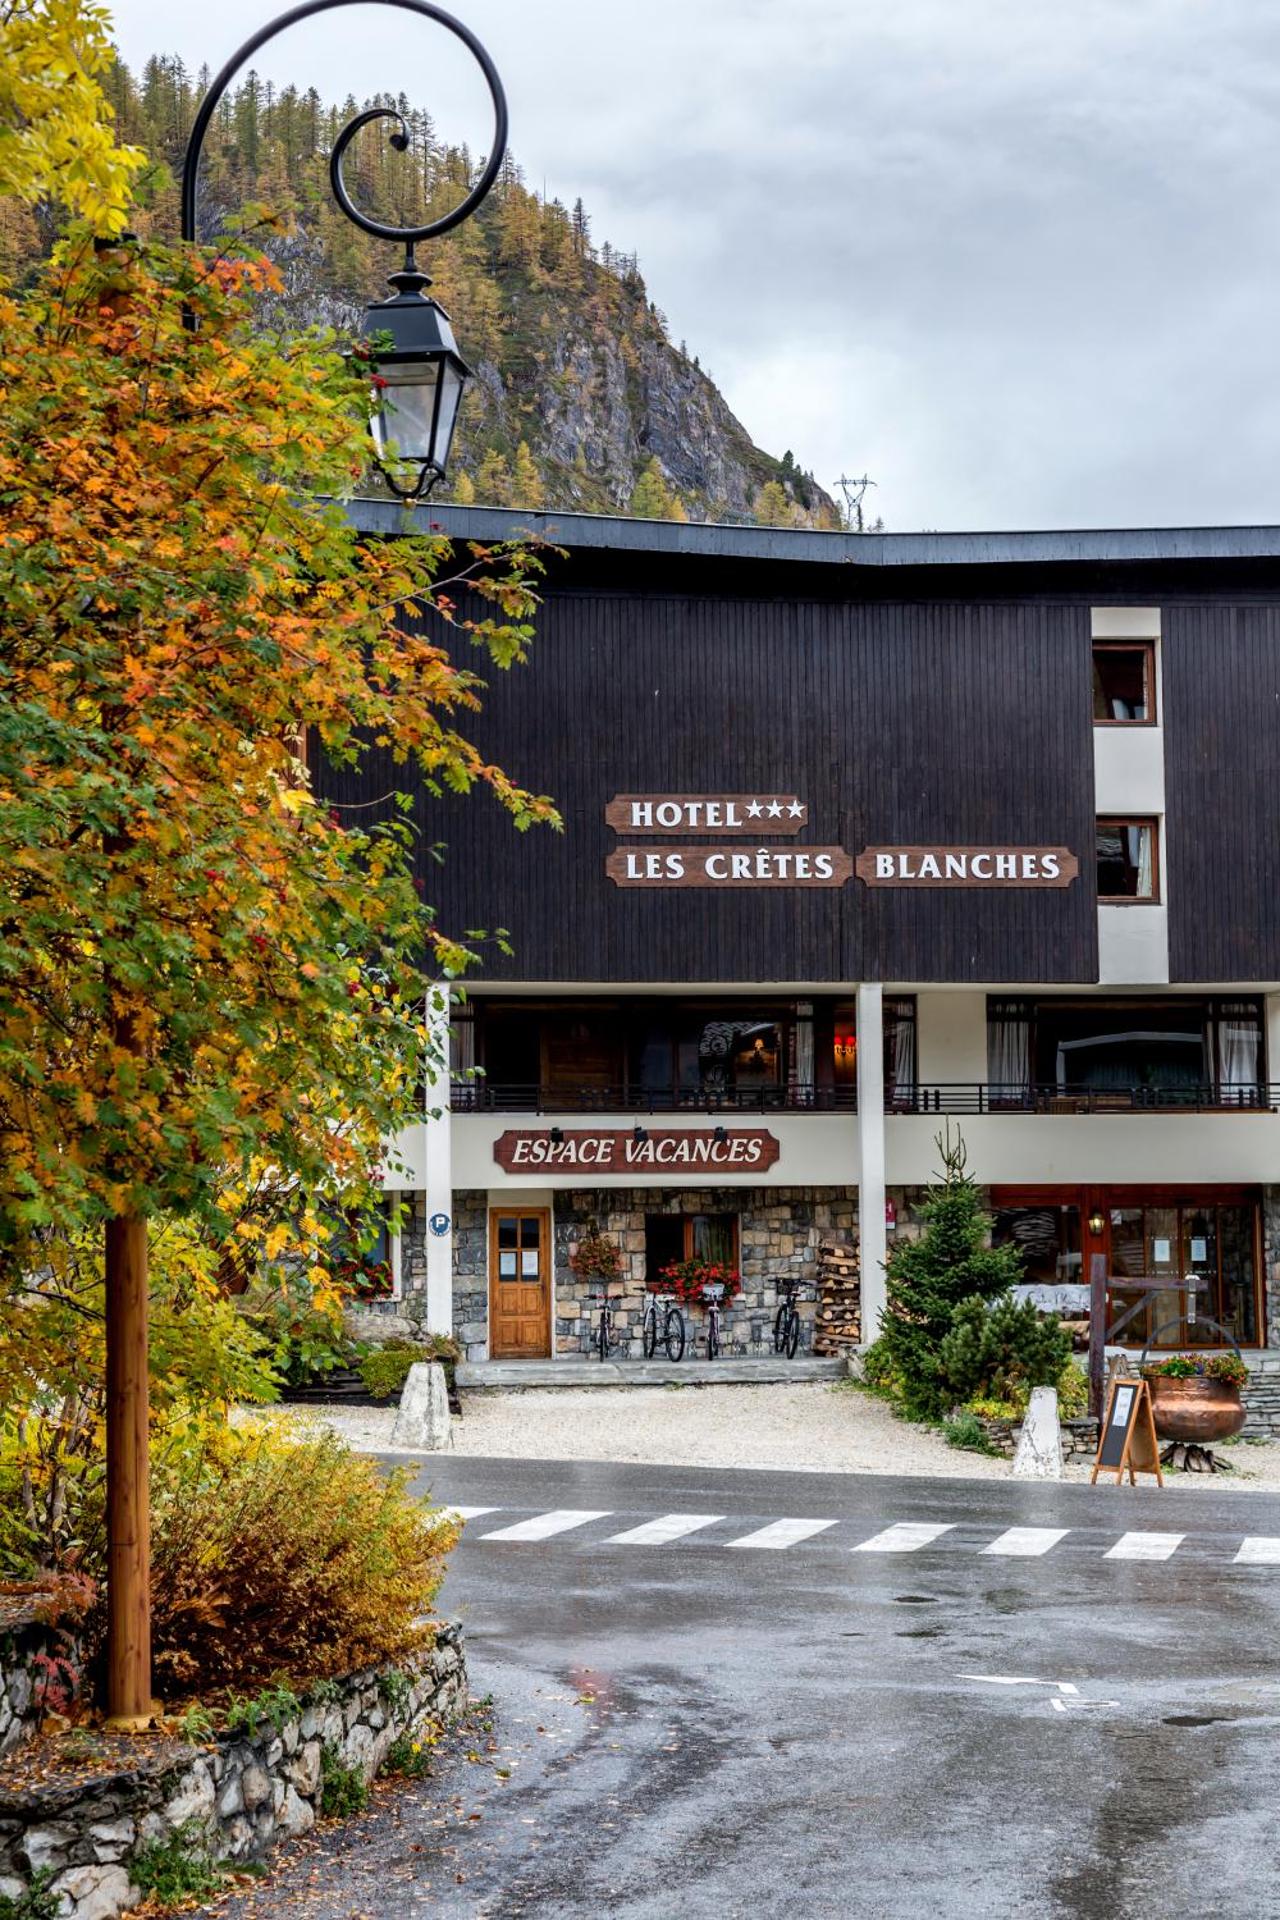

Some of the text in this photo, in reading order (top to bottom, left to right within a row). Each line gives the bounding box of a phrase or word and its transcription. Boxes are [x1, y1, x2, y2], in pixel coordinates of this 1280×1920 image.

[631, 802, 743, 827] HOTEL
[626, 848, 1061, 880] LES CRÊTES BLANCHES
[512, 1138, 763, 1163] ESPACE VACANCES
[435, 1216, 446, 1228] P
